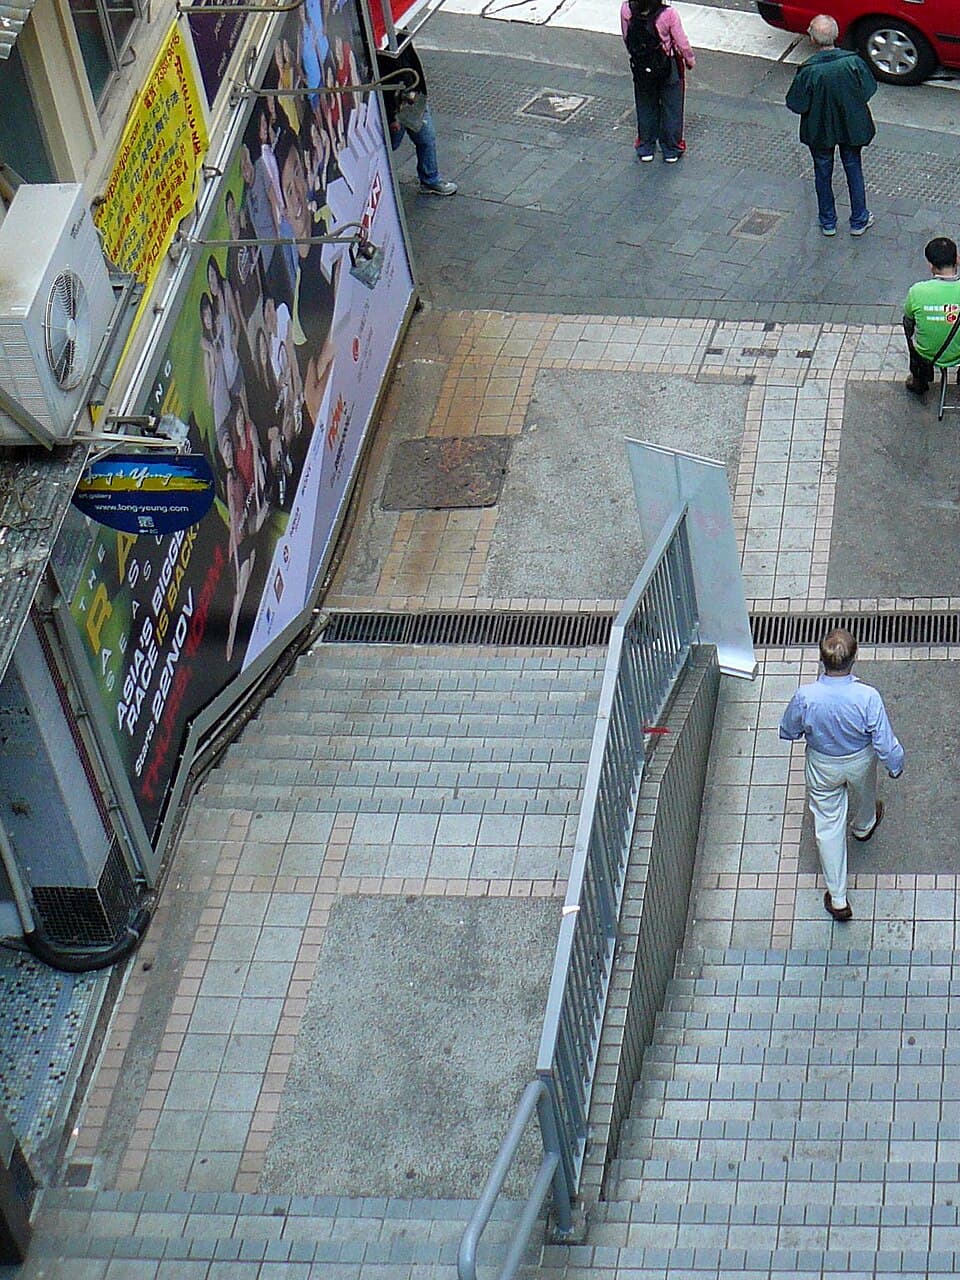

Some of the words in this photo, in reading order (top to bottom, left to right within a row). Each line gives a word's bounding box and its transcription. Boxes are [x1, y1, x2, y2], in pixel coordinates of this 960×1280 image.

[117, 616, 153, 731] ASIA'S
[152, 530, 185, 617] BIGGE
[126, 639, 158, 736] RACE
[156, 608, 169, 646] IS
[152, 586, 193, 724] 22NOV
